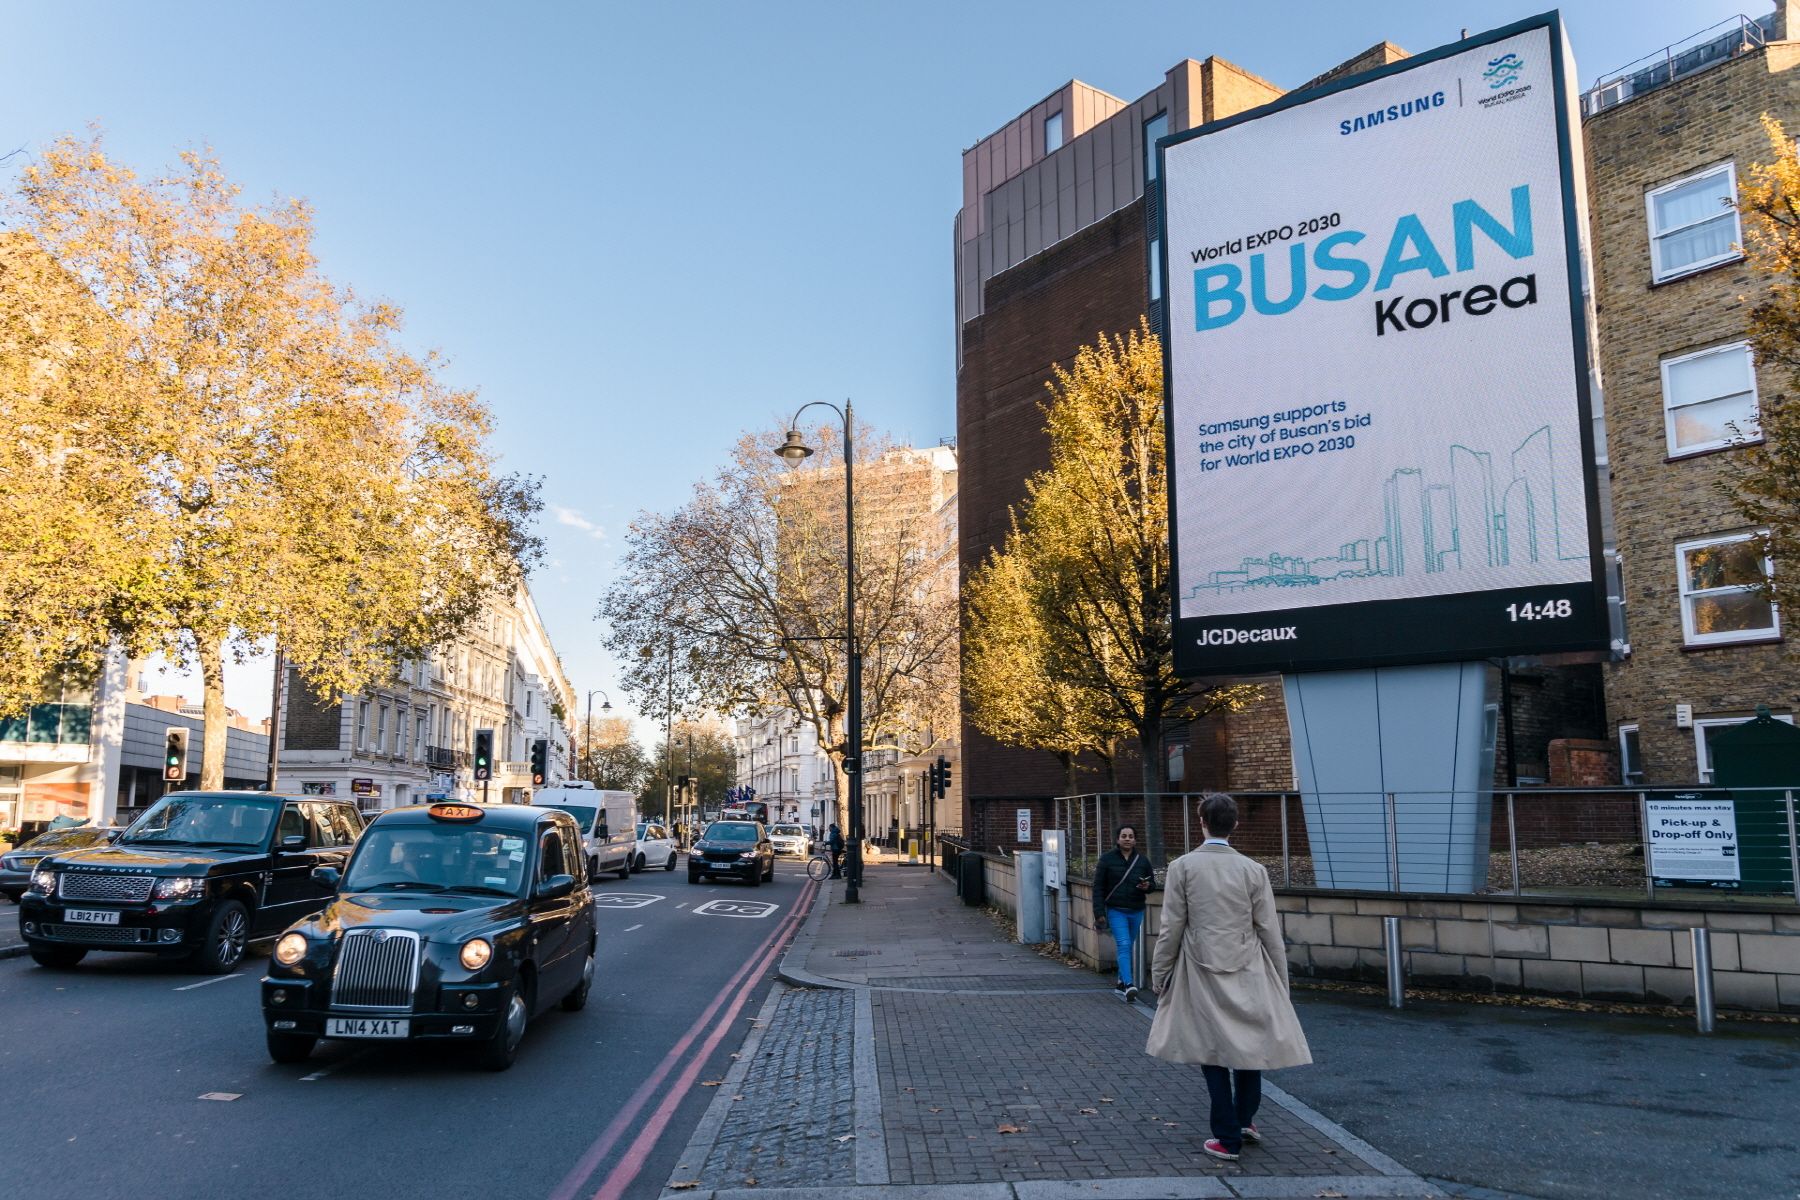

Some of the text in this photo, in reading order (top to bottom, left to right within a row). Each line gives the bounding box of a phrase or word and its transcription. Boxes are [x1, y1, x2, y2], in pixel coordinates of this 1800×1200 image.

[1340, 91, 1445, 136] SAMSUNG
[1191, 212, 1341, 264] World EXPO 2030
[1193, 184, 1534, 332] BUSAN
[1375, 273, 1538, 337] Korea
[1199, 400, 1347, 436] Samsung supports
[1199, 441, 1224, 454] the
[1228, 434, 1256, 450] city
[1260, 429, 1276, 444] of
[1344, 413, 1371, 430] bid
[1200, 434, 1355, 472] for World EXPO 2030
[1506, 598, 1572, 623] 14:48
[1196, 625, 1298, 646] JCDecaux
[438, 807, 471, 817] TAXI
[1713, 804, 1732, 812] stay
[1652, 830, 1734, 840] Drop-off Only
[1661, 818, 1721, 828] Pick-up &
[70, 911, 115, 922] LB12 FVT
[335, 1019, 400, 1035] LN14 XAT
